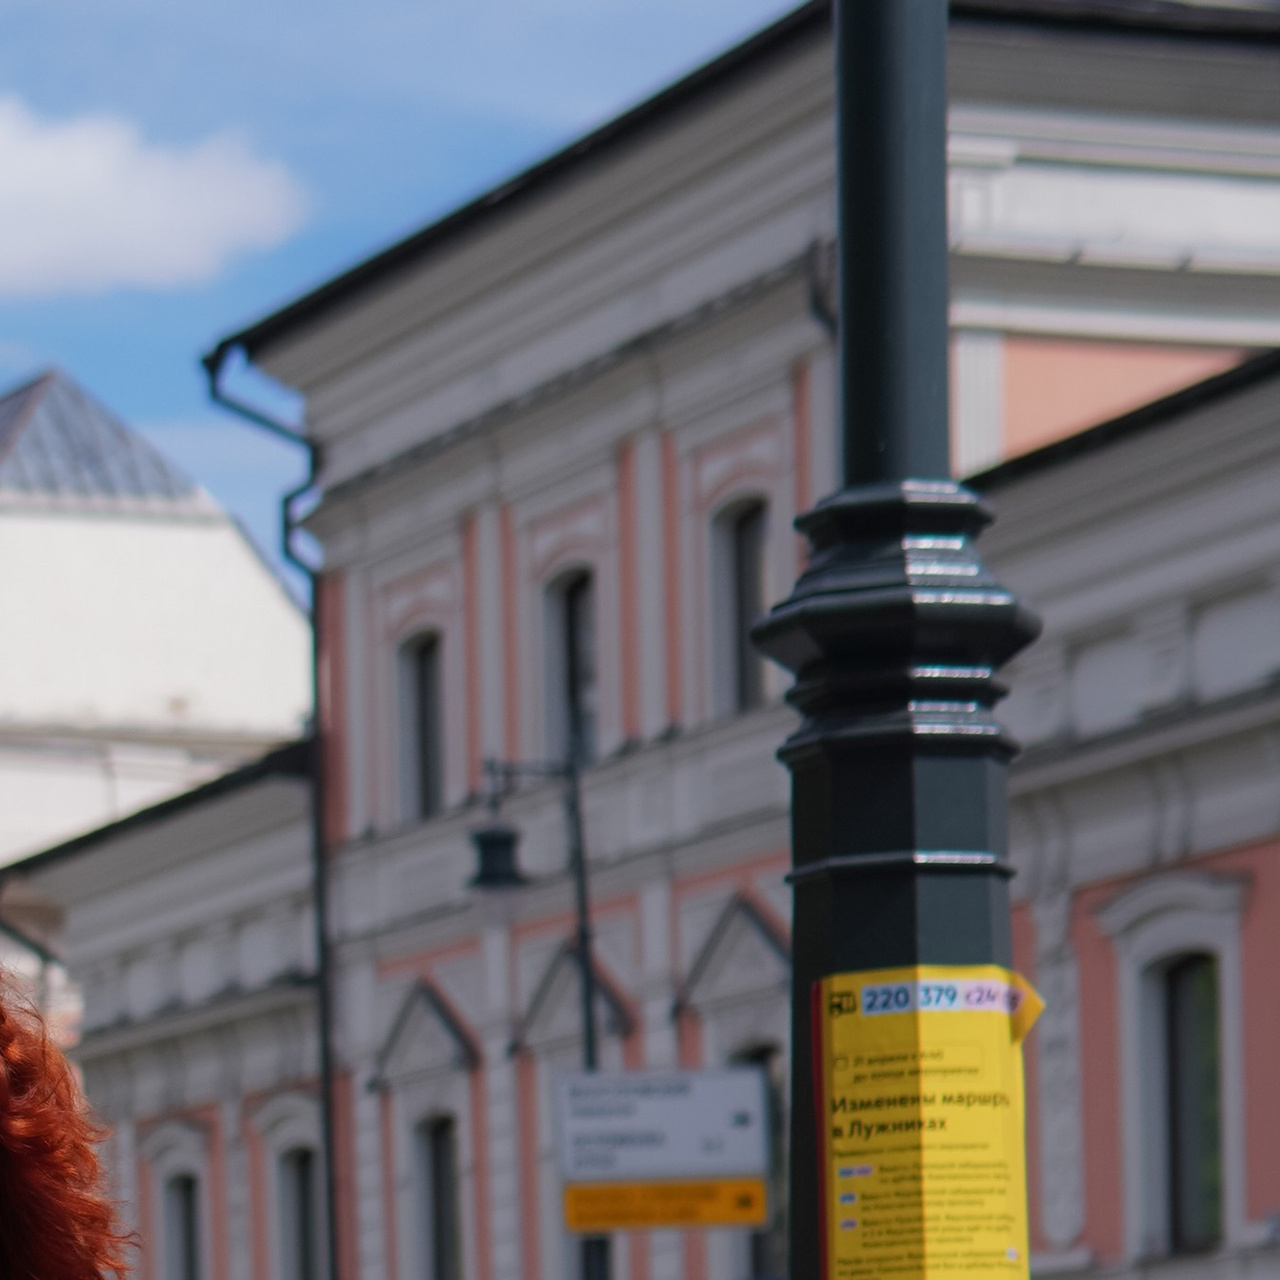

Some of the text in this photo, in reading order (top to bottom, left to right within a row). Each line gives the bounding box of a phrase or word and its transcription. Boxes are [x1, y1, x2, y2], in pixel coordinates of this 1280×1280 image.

[864, 986, 910, 1013] 220
[920, 984, 958, 1007] 379
[831, 1093, 936, 1114] Изменены
[848, 1118, 947, 1141] Лужниках
